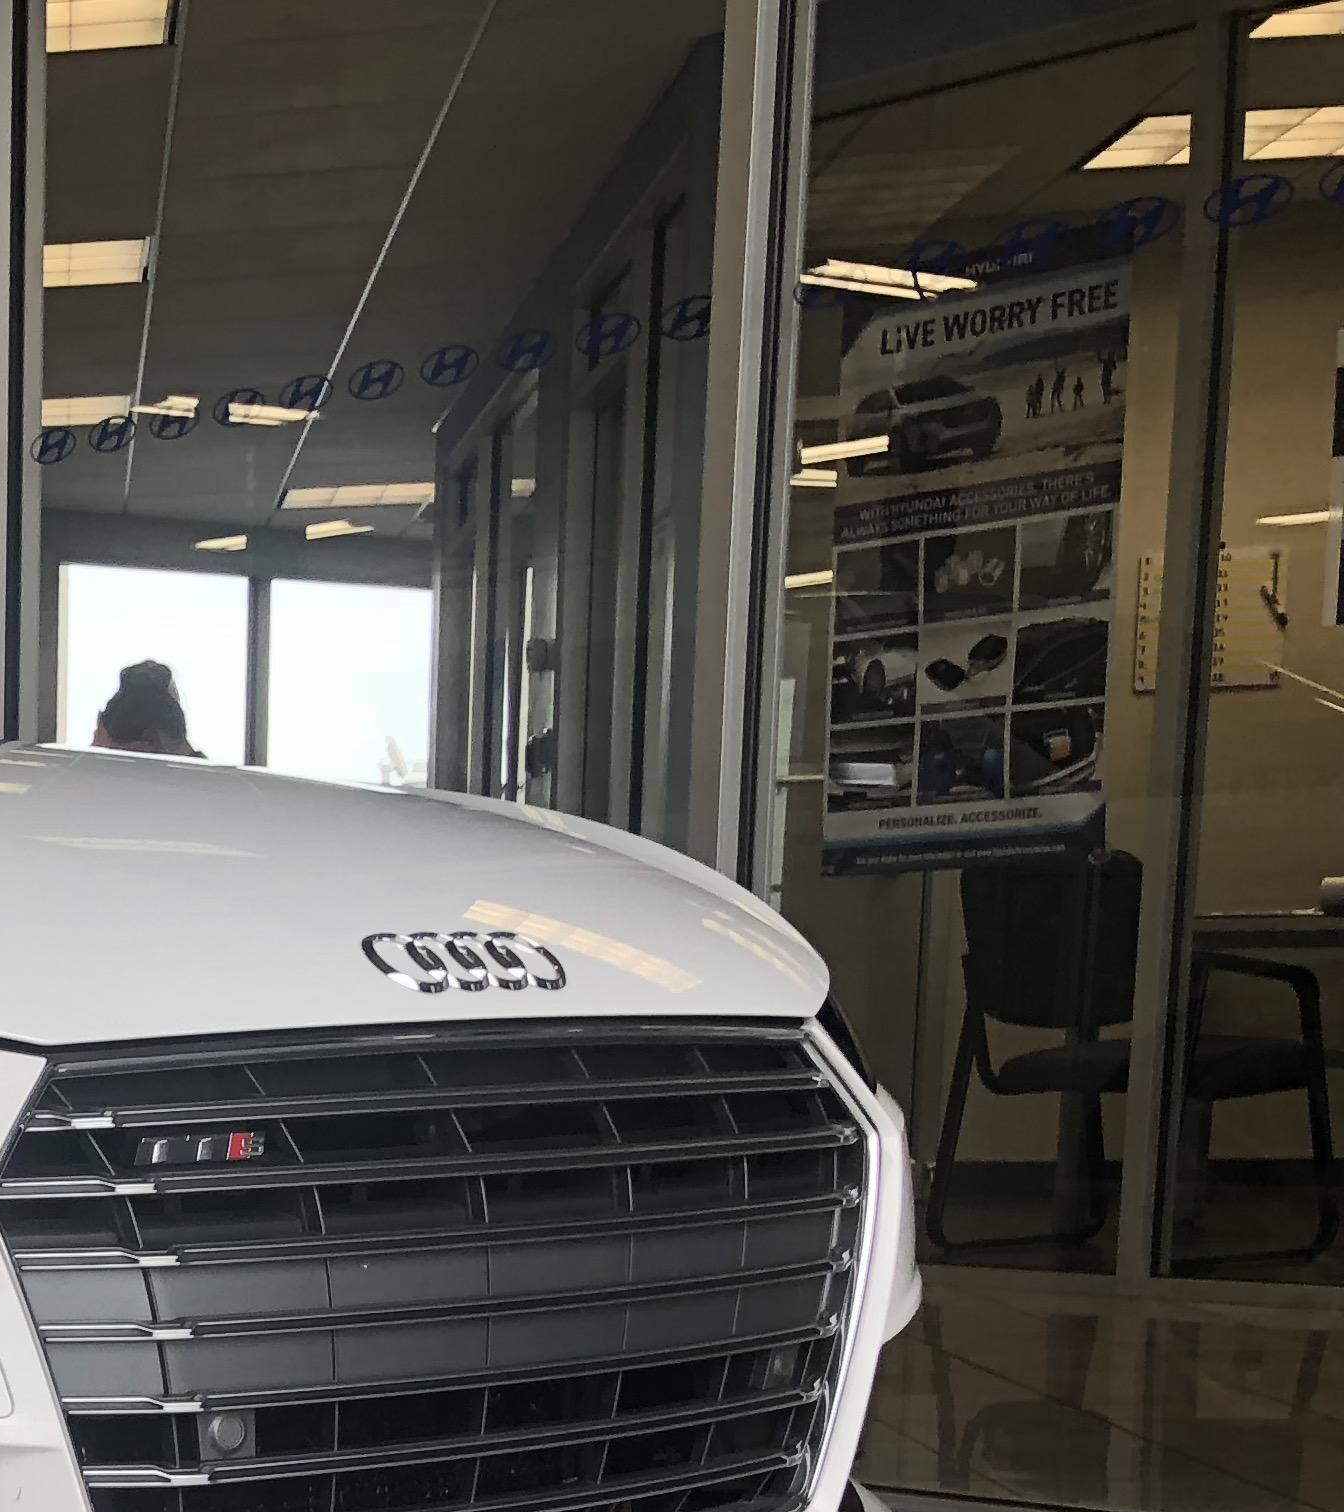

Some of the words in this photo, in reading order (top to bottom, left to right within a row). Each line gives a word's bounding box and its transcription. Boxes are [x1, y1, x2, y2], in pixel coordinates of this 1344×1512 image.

[879, 318, 936, 355] LIVE
[942, 296, 1043, 342] WORRY
[1050, 279, 1120, 320] FREE
[890, 496, 946, 516] HYUNDAI
[891, 510, 961, 532] SOMETHING
[964, 503, 990, 521] FOR
[993, 499, 1027, 518] YOUR
[1028, 493, 1059, 511] WAY
[1061, 489, 1078, 505] OF
[960, 807, 1043, 824] ACCESSORIZE.
